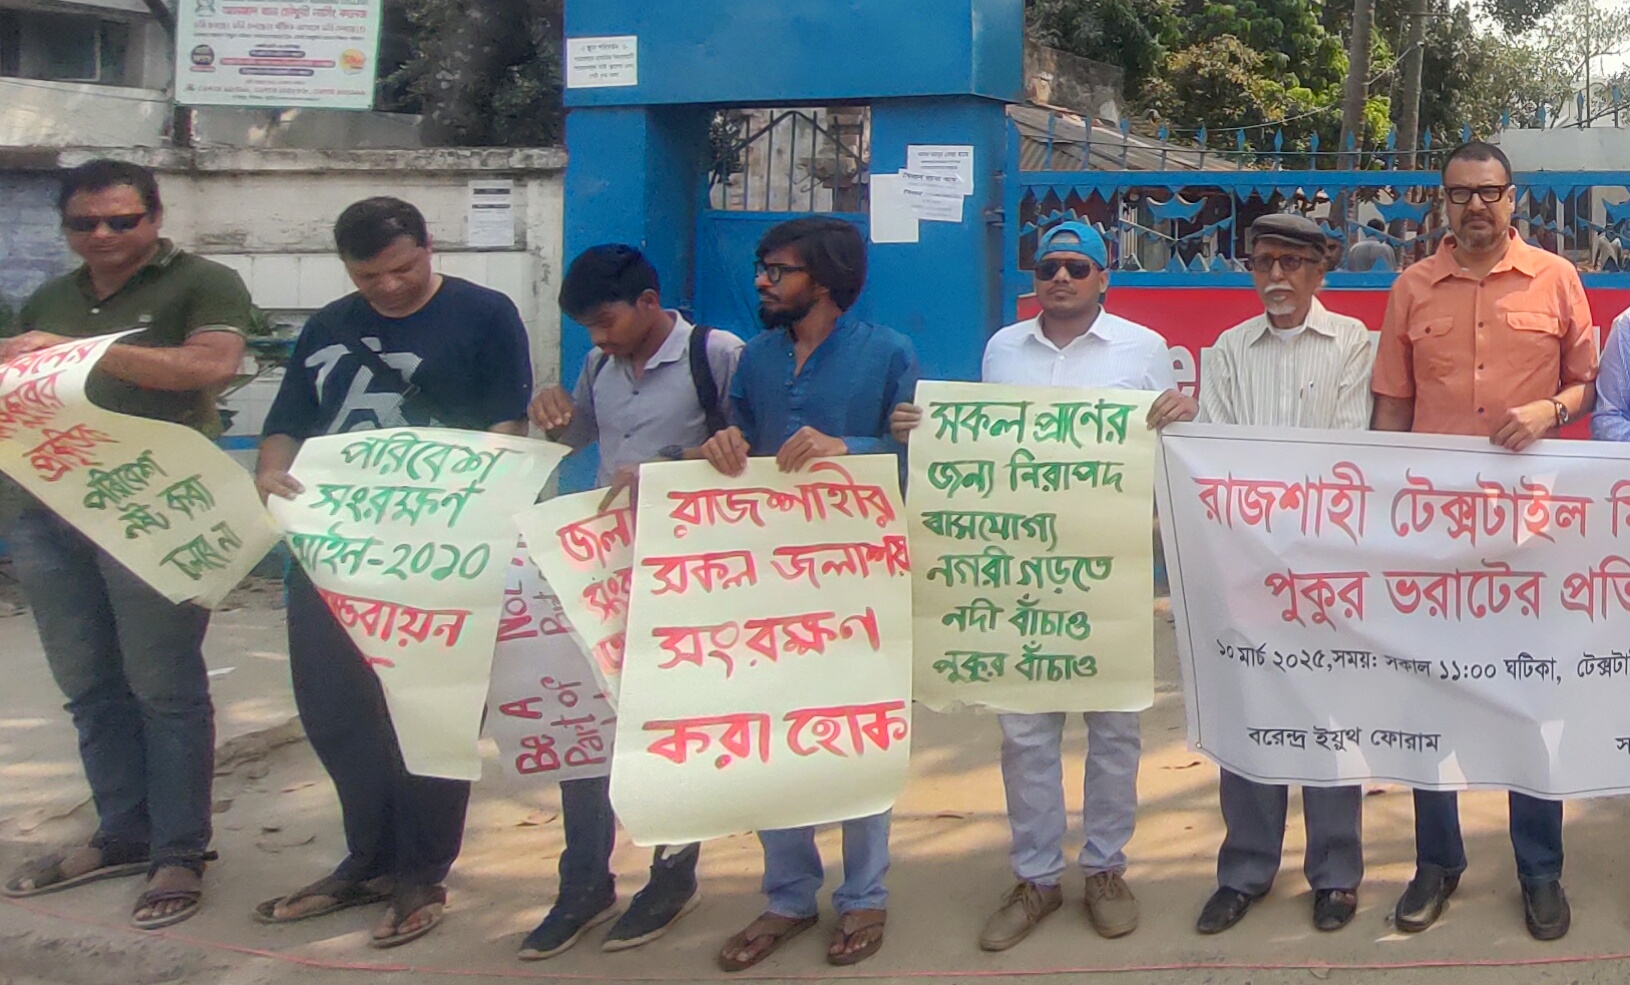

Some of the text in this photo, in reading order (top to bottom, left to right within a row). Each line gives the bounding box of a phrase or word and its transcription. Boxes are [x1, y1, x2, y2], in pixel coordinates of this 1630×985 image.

[929, 399, 1137, 448] সকল প্রাণের
[82, 449, 167, 510] পরিবেশ
[341, 432, 512, 482] পরিবেশ
[928, 449, 1125, 499] জন্য নিরাপদ
[308, 481, 486, 528] সংরক্ষণ
[667, 462, 898, 539] রাজশাহীর
[1192, 462, 1375, 545] রাজশাহী
[1391, 468, 1593, 548] টেক্সটাইল
[922, 510, 1058, 551] বাসযোগ্য
[641, 535, 911, 595] সকল জলাশয়
[926, 546, 1113, 594] নগরী গড়তে
[942, 593, 1091, 640] নদী বাঁচাও
[1265, 568, 1371, 631] পুকুর
[1382, 559, 1547, 623] ভরাটের
[652, 606, 880, 680] সংরক্ষণ
[933, 640, 1098, 683] পুকুর বাঁচাও
[1238, 643, 1266, 668] মার্চ
[1384, 655, 1432, 677] সকাল
[1438, 659, 1497, 681] ১১:০০
[1504, 652, 1562, 685] ঘটিকা,
[539, 675, 582, 709] of
[499, 696, 561, 775] Be A
[550, 713, 608, 770] Part
[642, 712, 772, 769] করা
[783, 699, 908, 758] হোক
[1248, 726, 1441, 752] বরেন্দ্র ইয়ুথ ফোরাম
